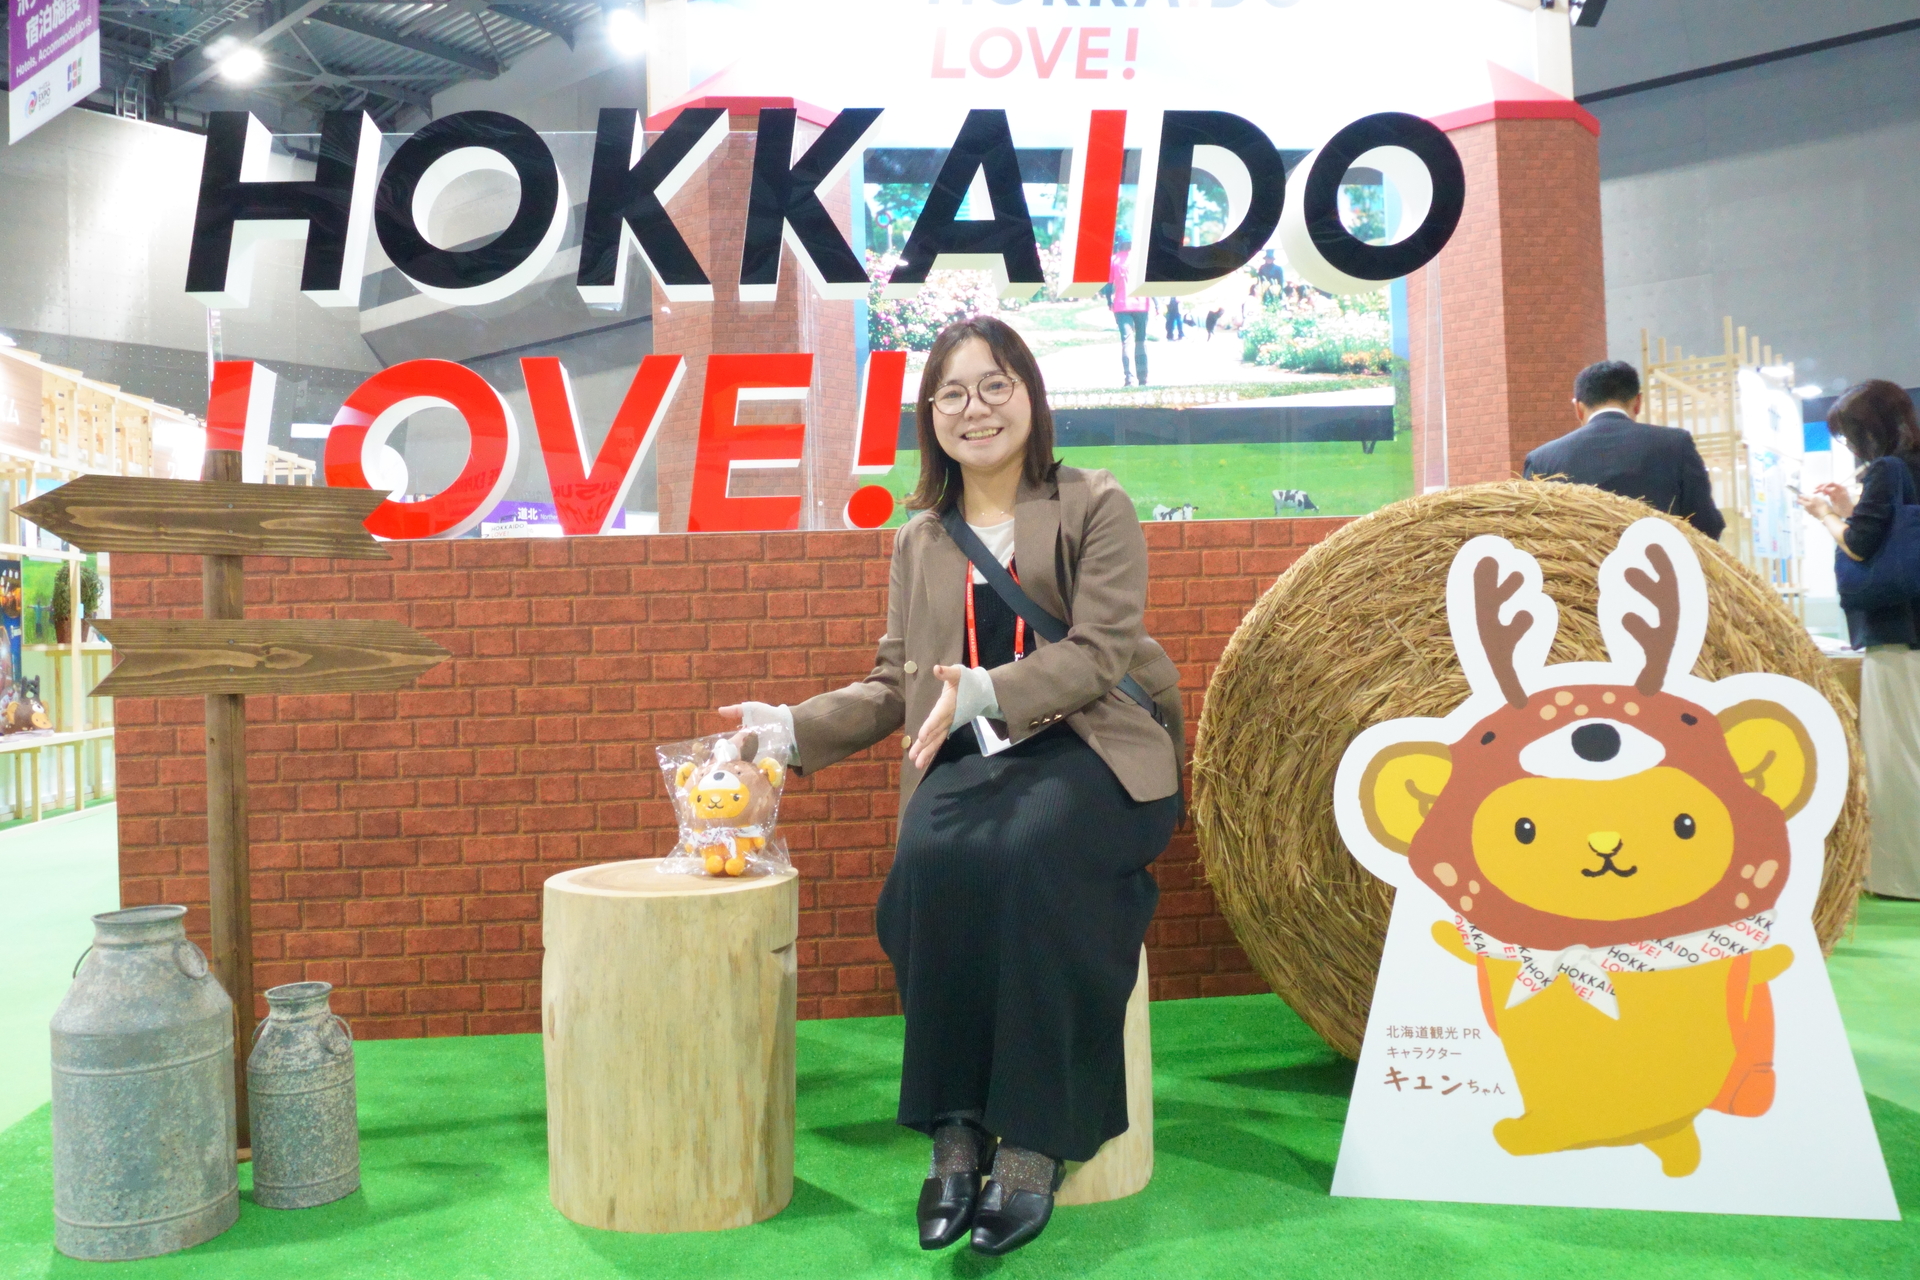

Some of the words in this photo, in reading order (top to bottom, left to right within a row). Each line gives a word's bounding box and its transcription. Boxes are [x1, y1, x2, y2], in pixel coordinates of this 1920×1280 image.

[38, 15, 92, 62] Accommodations
[930, 26, 1139, 80] LOVE!
[185, 106, 1466, 293] HOKKAIDO
[517, 507, 538, 521] 道北
[490, 522, 525, 532] HOKKAIDO
[1386, 1025, 1459, 1040] 北海道観光
[1463, 1028, 1482, 1039] PR
[1386, 1046, 1462, 1060] キャラクター
[1383, 1066, 1506, 1096] キュンちゃん
